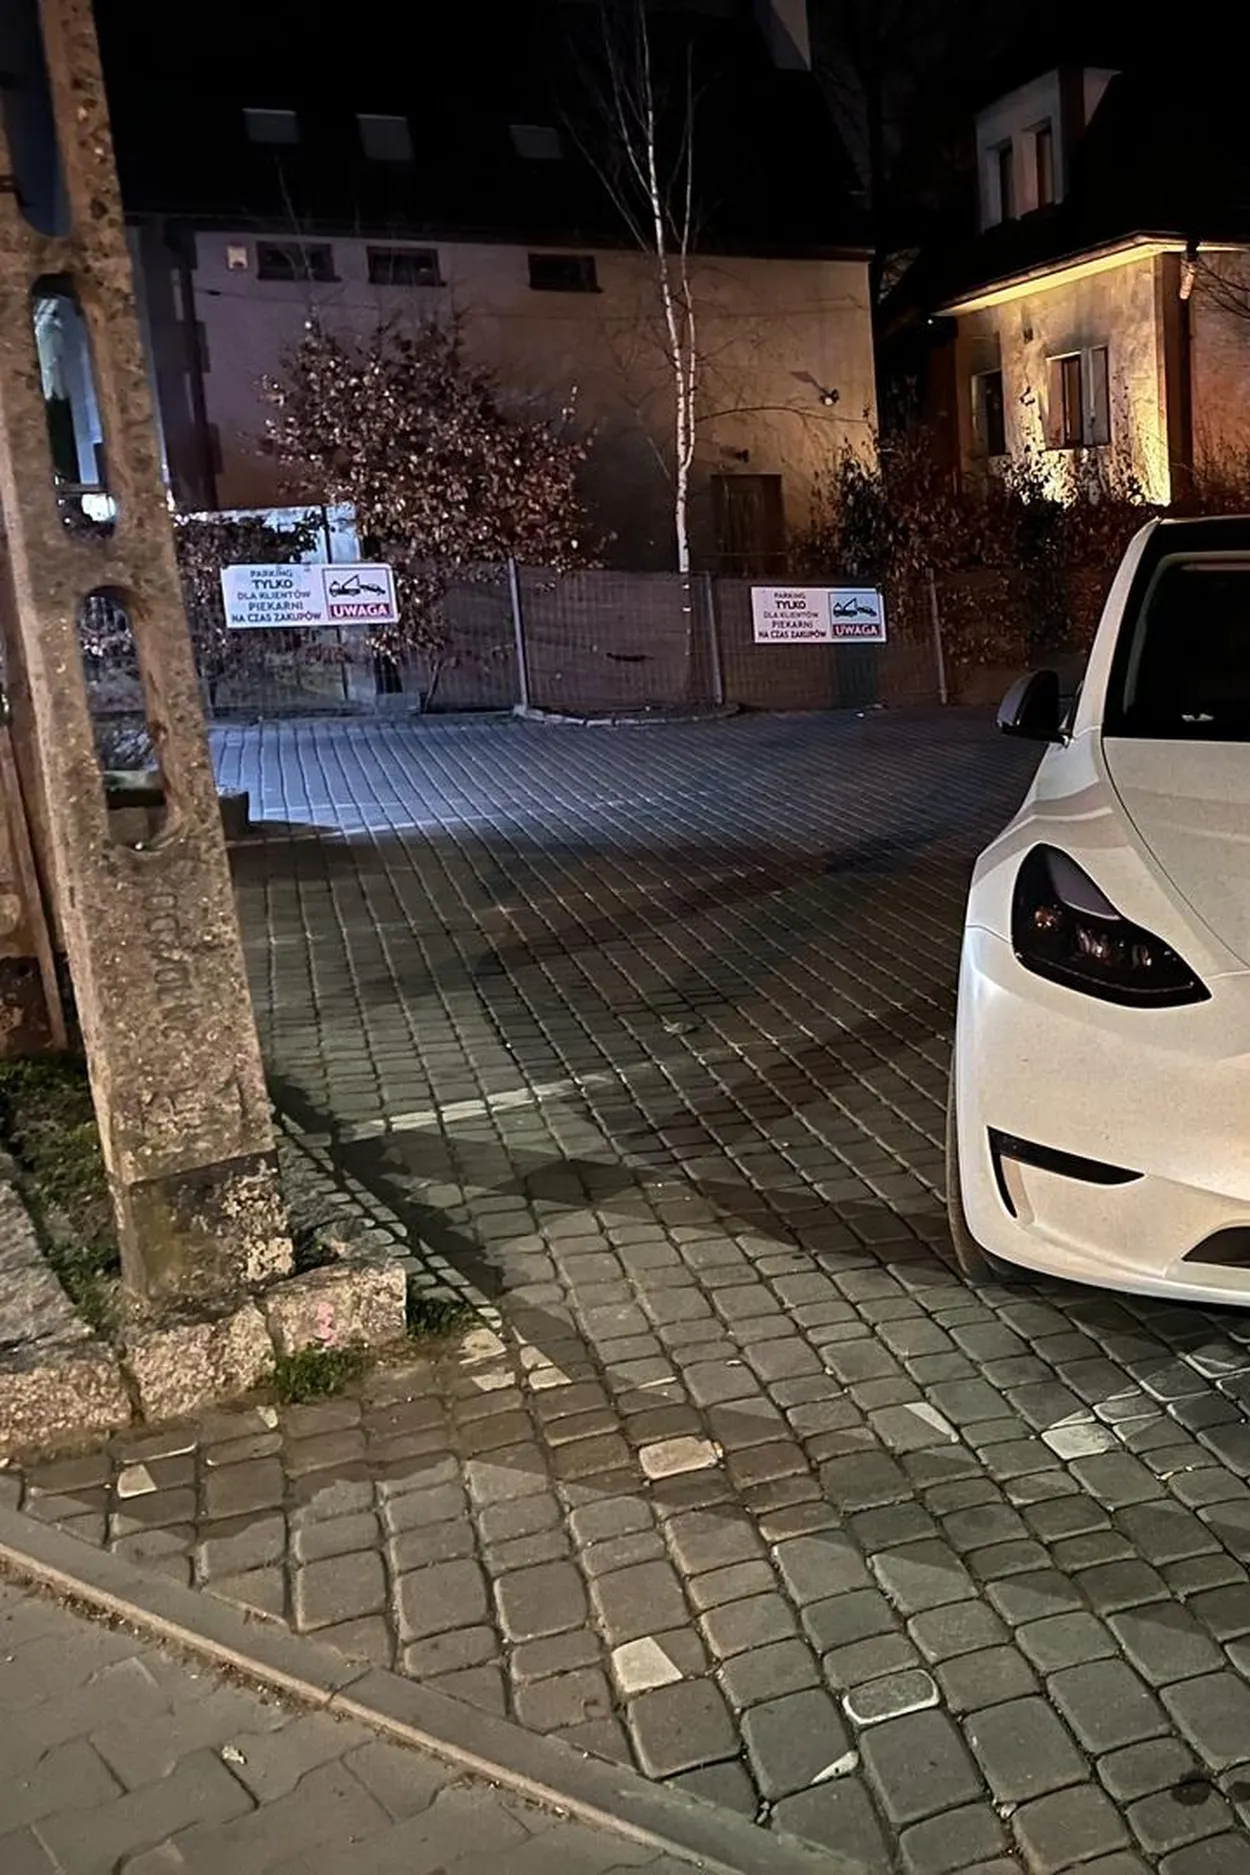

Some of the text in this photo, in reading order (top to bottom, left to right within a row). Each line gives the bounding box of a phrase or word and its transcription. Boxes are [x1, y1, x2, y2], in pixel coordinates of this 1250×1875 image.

[250, 569, 293, 578] PARKING
[251, 579, 294, 589] TYLKO
[237, 589, 311, 600] DLA KLIENTÓW
[248, 601, 304, 611] PIEKARNI
[776, 600, 806, 609] TYLKO
[333, 604, 388, 617] UWAGA
[232, 610, 321, 622] NA CZAS ZAKUPÓW
[772, 620, 813, 628] PIEKARNI
[835, 624, 878, 637] UWAGA
